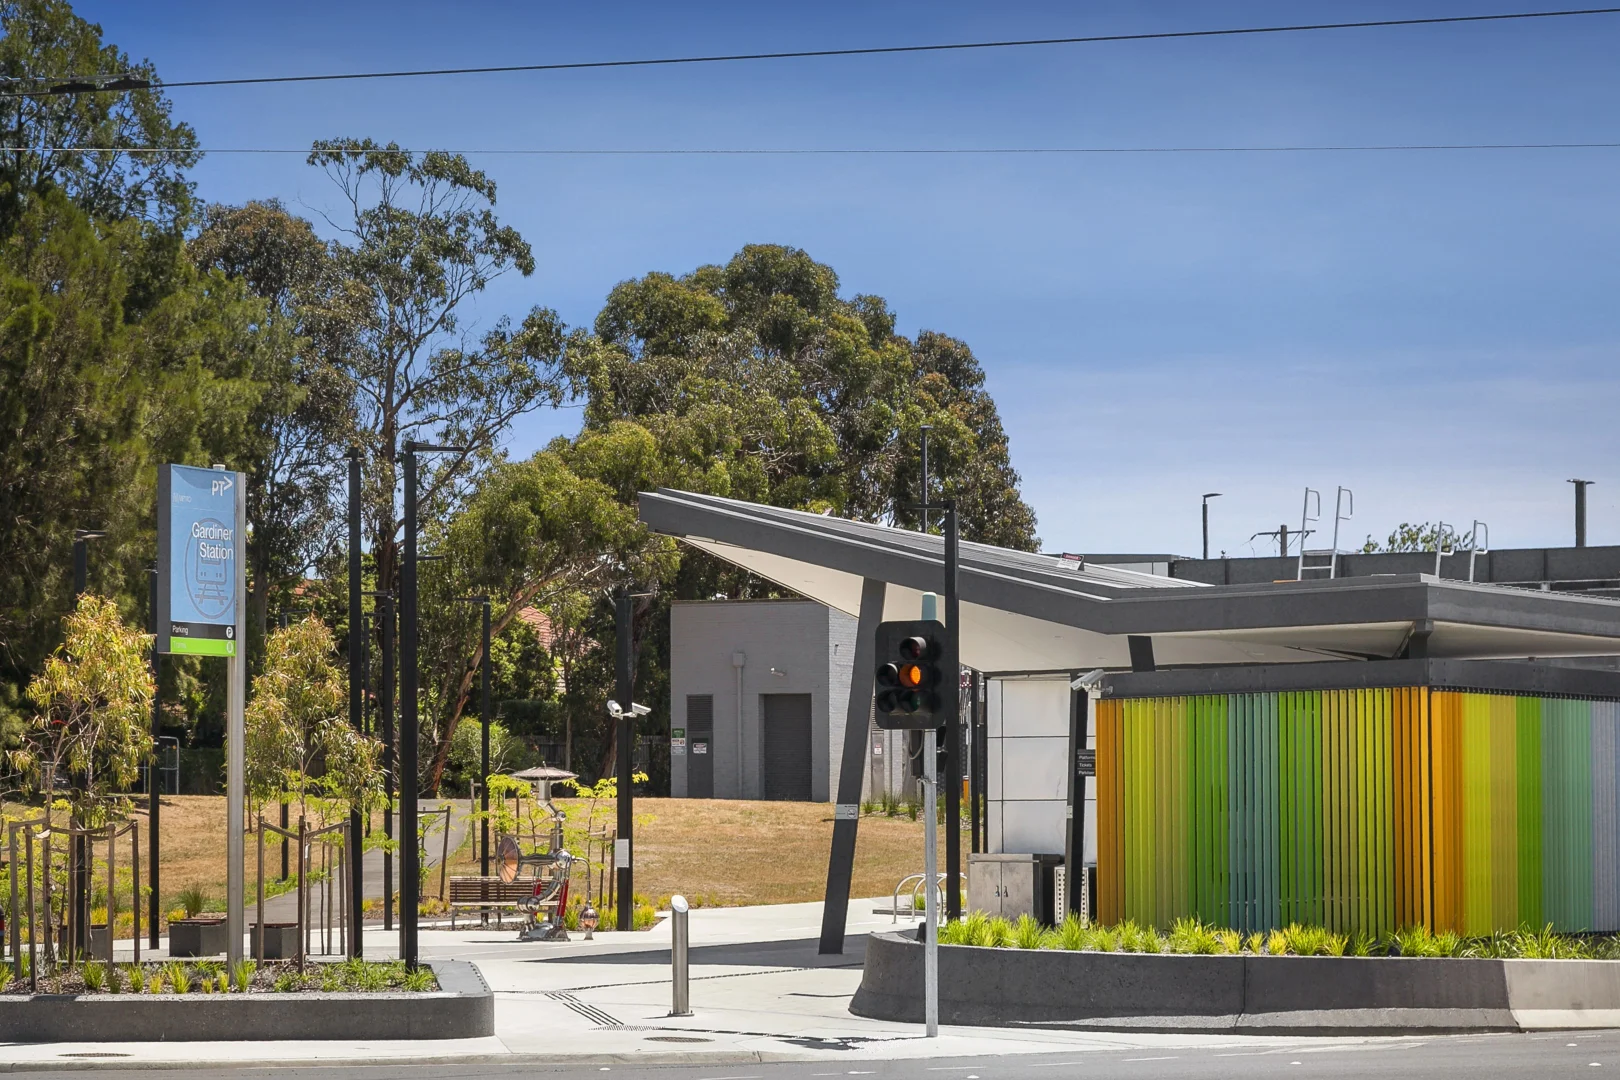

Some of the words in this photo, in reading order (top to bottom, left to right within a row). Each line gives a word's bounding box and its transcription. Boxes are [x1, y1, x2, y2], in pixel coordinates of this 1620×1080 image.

[192, 522, 233, 541] Gardiner
[199, 542, 234, 560] Station
[172, 624, 189, 636] Parking
